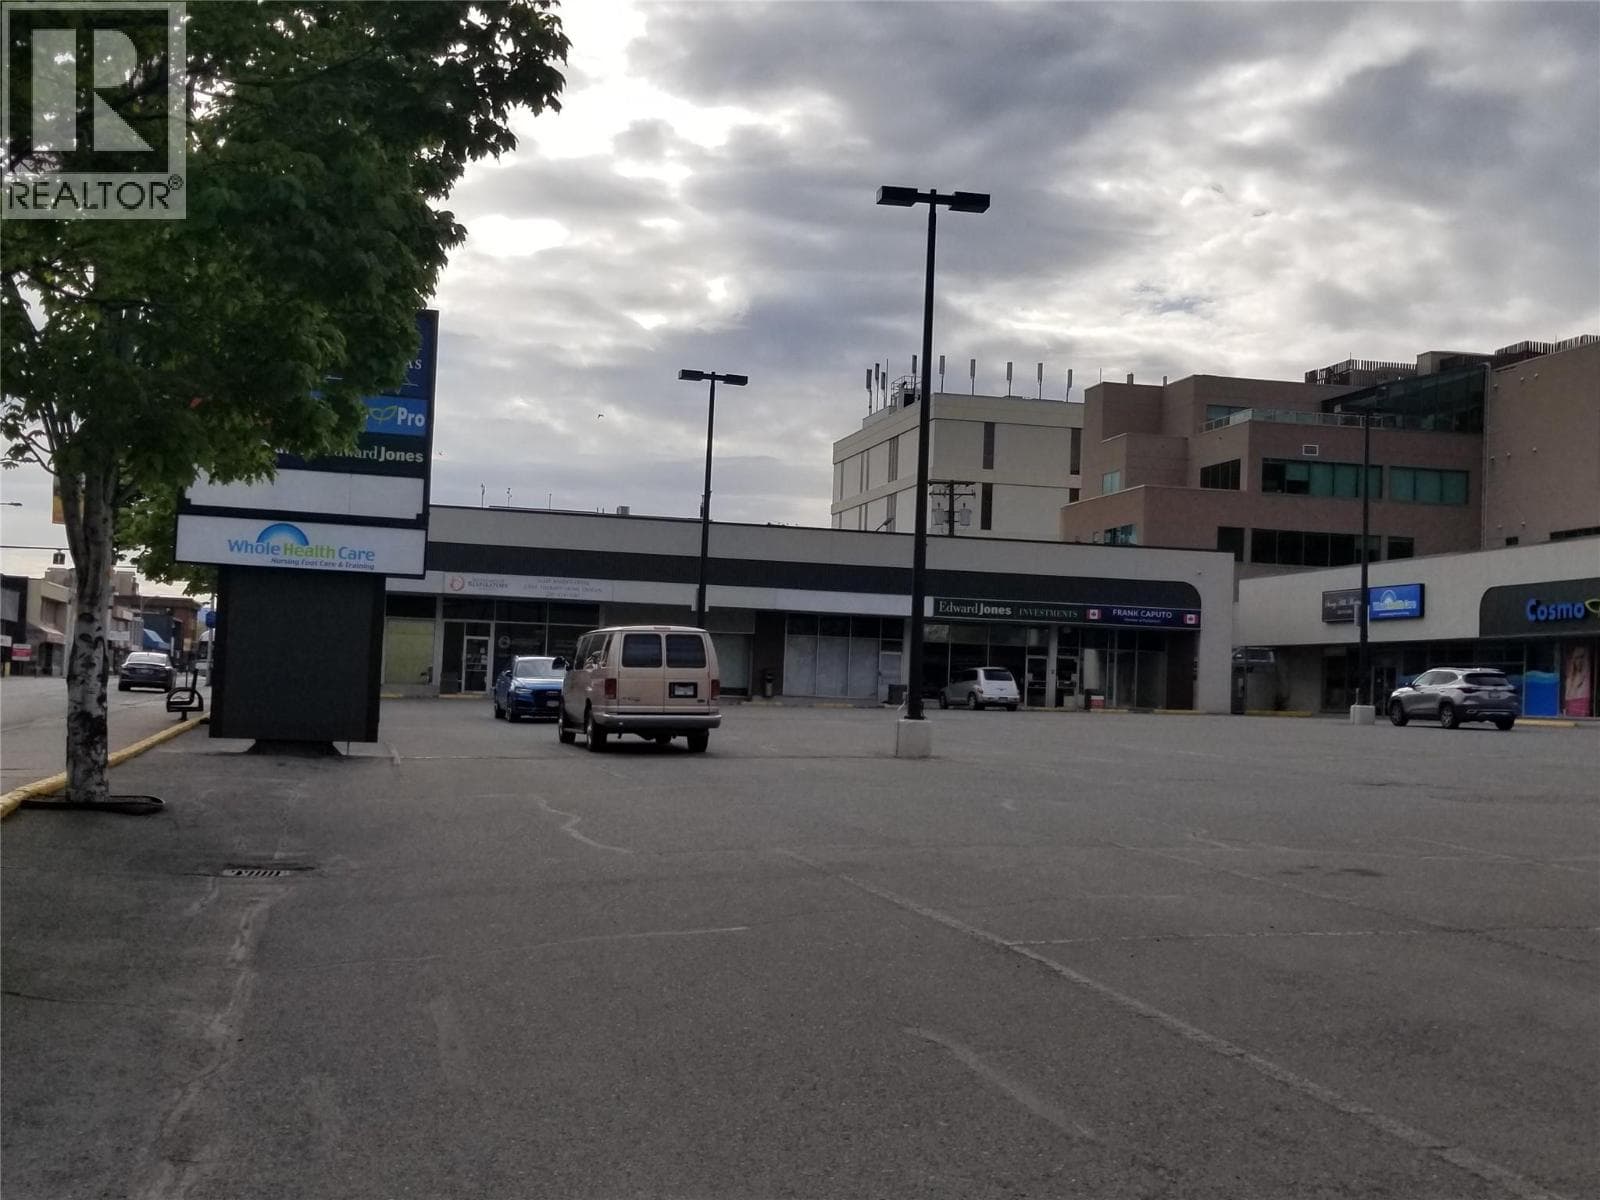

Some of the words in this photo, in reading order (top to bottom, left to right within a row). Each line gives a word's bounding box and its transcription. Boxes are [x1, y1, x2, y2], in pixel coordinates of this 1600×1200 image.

[397, 406, 426, 427] Pro
[378, 446, 424, 463] Jones
[228, 539, 281, 556] Whole
[283, 543, 336, 560] Health
[338, 546, 376, 562] Care
[938, 600, 978, 614] Edward
[978, 602, 1013, 615] Jones
[1018, 607, 1078, 618] INVESTMENTS
[1112, 608, 1139, 617] FRANK
[1140, 610, 1173, 619] CAPUTO
[1526, 598, 1585, 622] Cosmo
